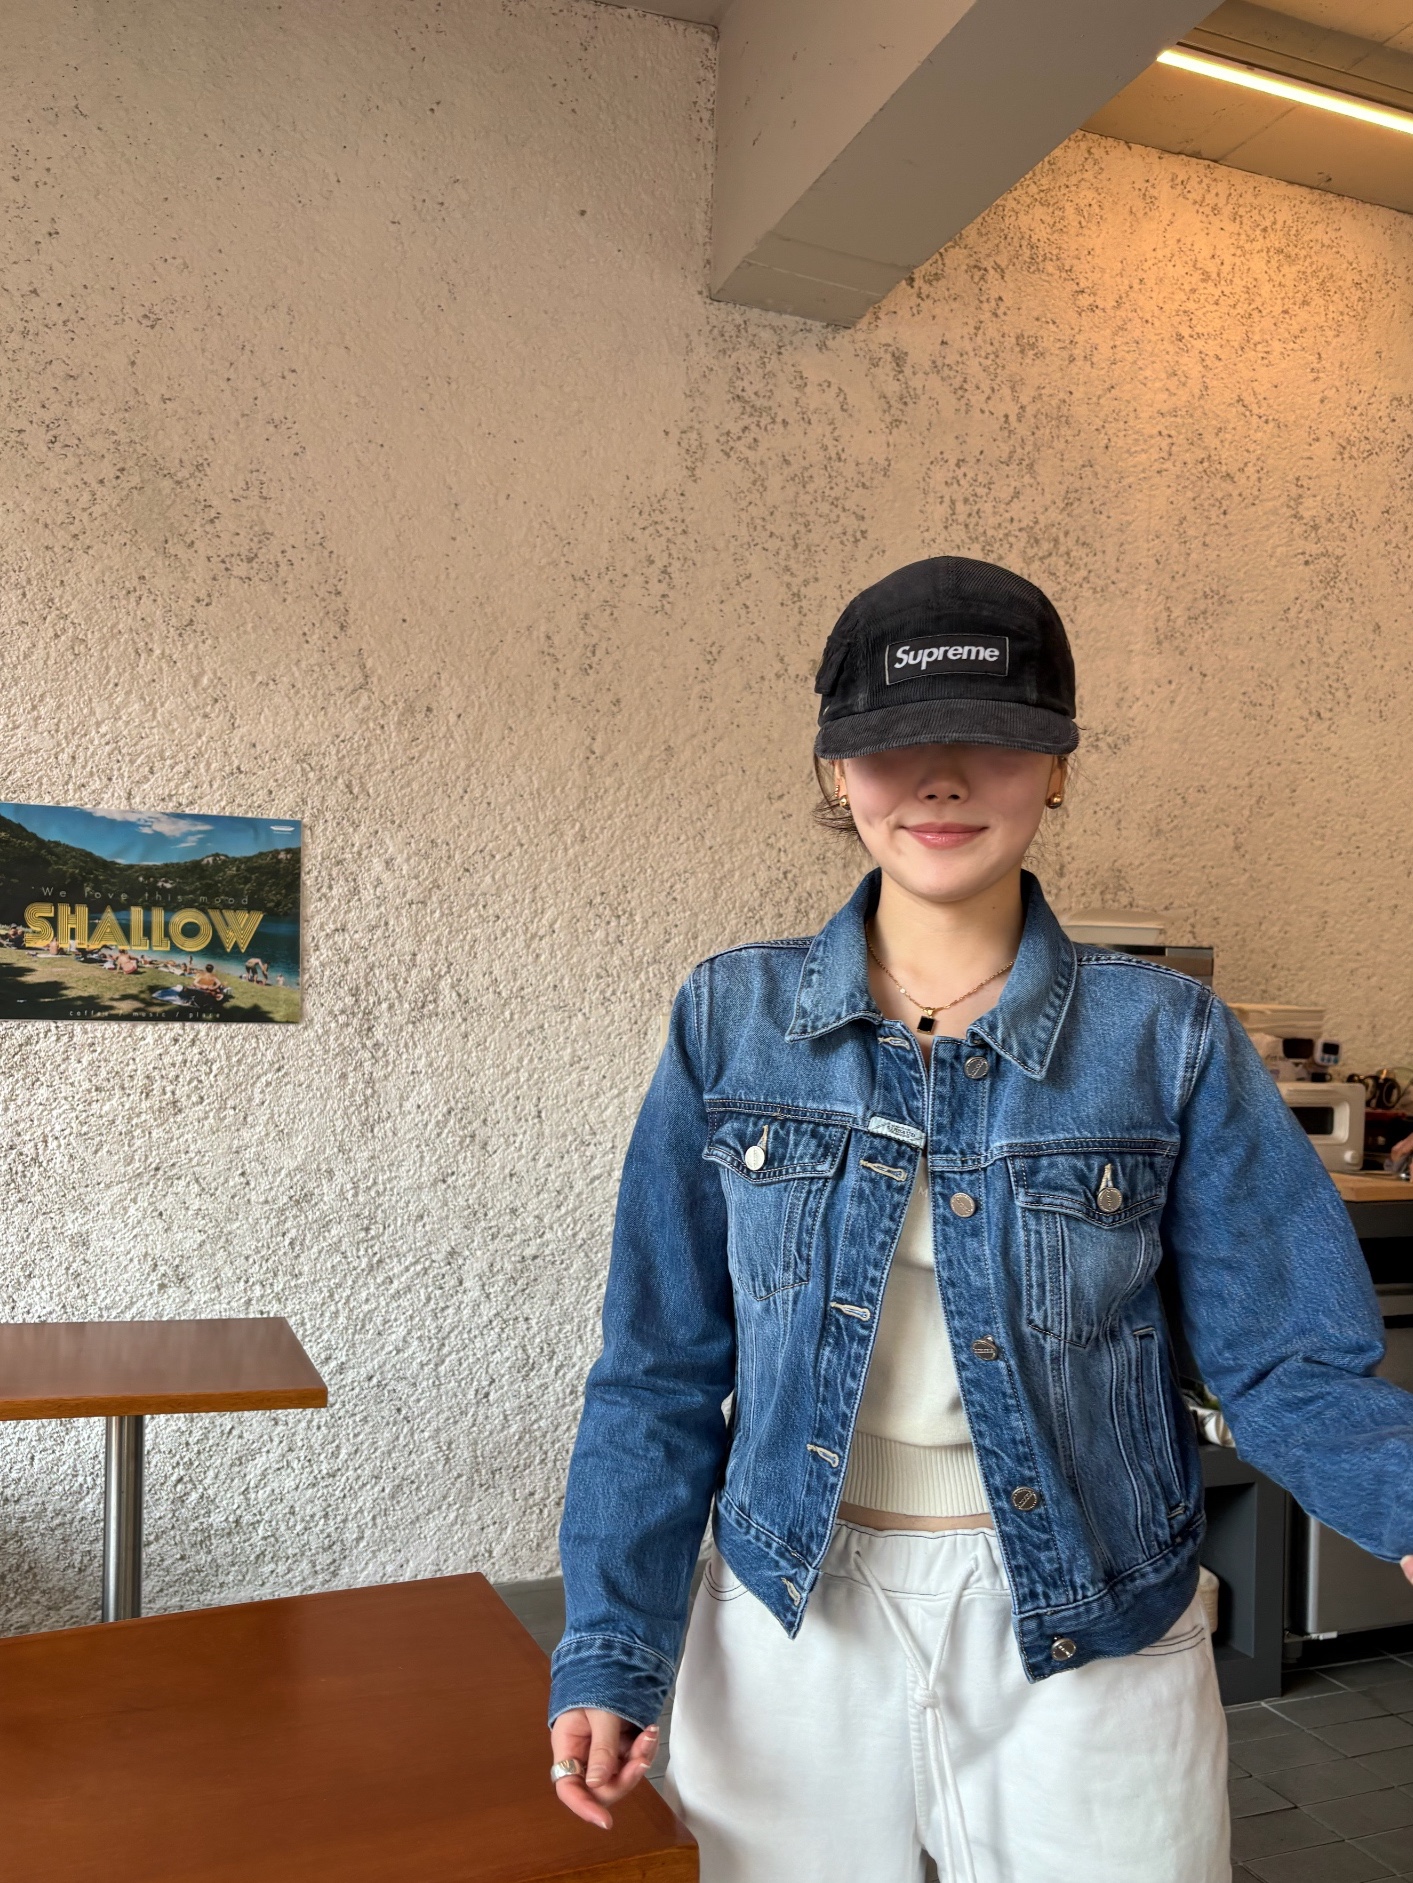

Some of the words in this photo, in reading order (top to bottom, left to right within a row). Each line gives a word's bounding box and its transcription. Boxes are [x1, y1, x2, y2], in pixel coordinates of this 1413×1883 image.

[894, 645, 1000, 670] Supreme
[41, 886, 67, 898] We
[84, 885, 128, 900] love
[144, 891, 183, 902] this
[199, 895, 249, 905] mood
[24, 901, 264, 953] SHALLOW
[69, 1009, 109, 1018] coffee
